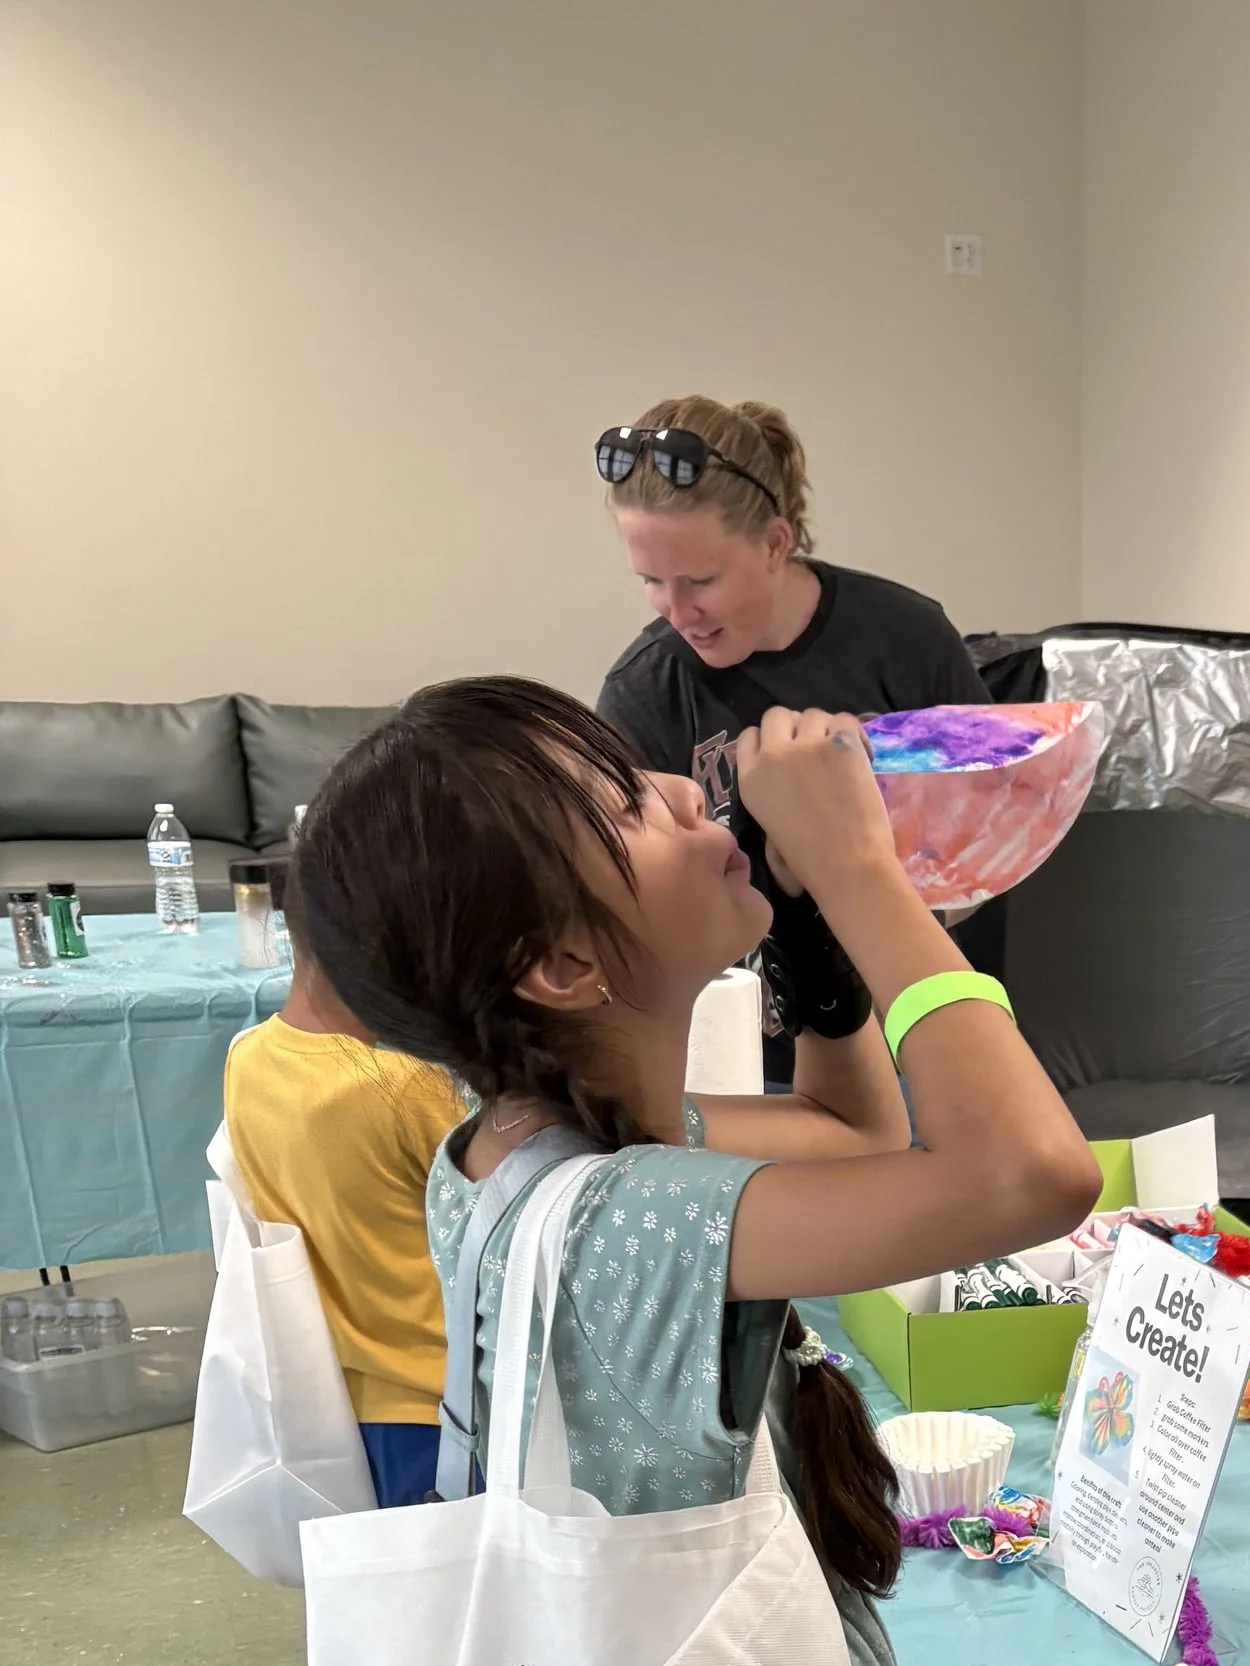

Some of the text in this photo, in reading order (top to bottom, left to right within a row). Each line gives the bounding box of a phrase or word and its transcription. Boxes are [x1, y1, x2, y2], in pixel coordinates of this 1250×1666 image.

[1154, 1273, 1205, 1332] Lets
[1126, 1306, 1210, 1384] Create!
[1166, 1400, 1180, 1414] Grab
[1180, 1409, 1197, 1424] Coffee
[1157, 1425, 1171, 1439] Color
[1178, 1440, 1191, 1451] over
[1190, 1447, 1207, 1461] coffee
[1174, 1421, 1188, 1435] some
[1187, 1430, 1209, 1448] markers
[1163, 1460, 1178, 1475] spray
[1178, 1471, 1193, 1484] water
[1192, 1481, 1201, 1489] on
[1139, 1491, 1186, 1525] around center and
[1145, 1478, 1159, 1492] Twist
[1167, 1494, 1186, 1511] cleaner
[1139, 1505, 1148, 1515] use
[1148, 1511, 1168, 1528] another
[1136, 1518, 1176, 1549] cleaner to make
